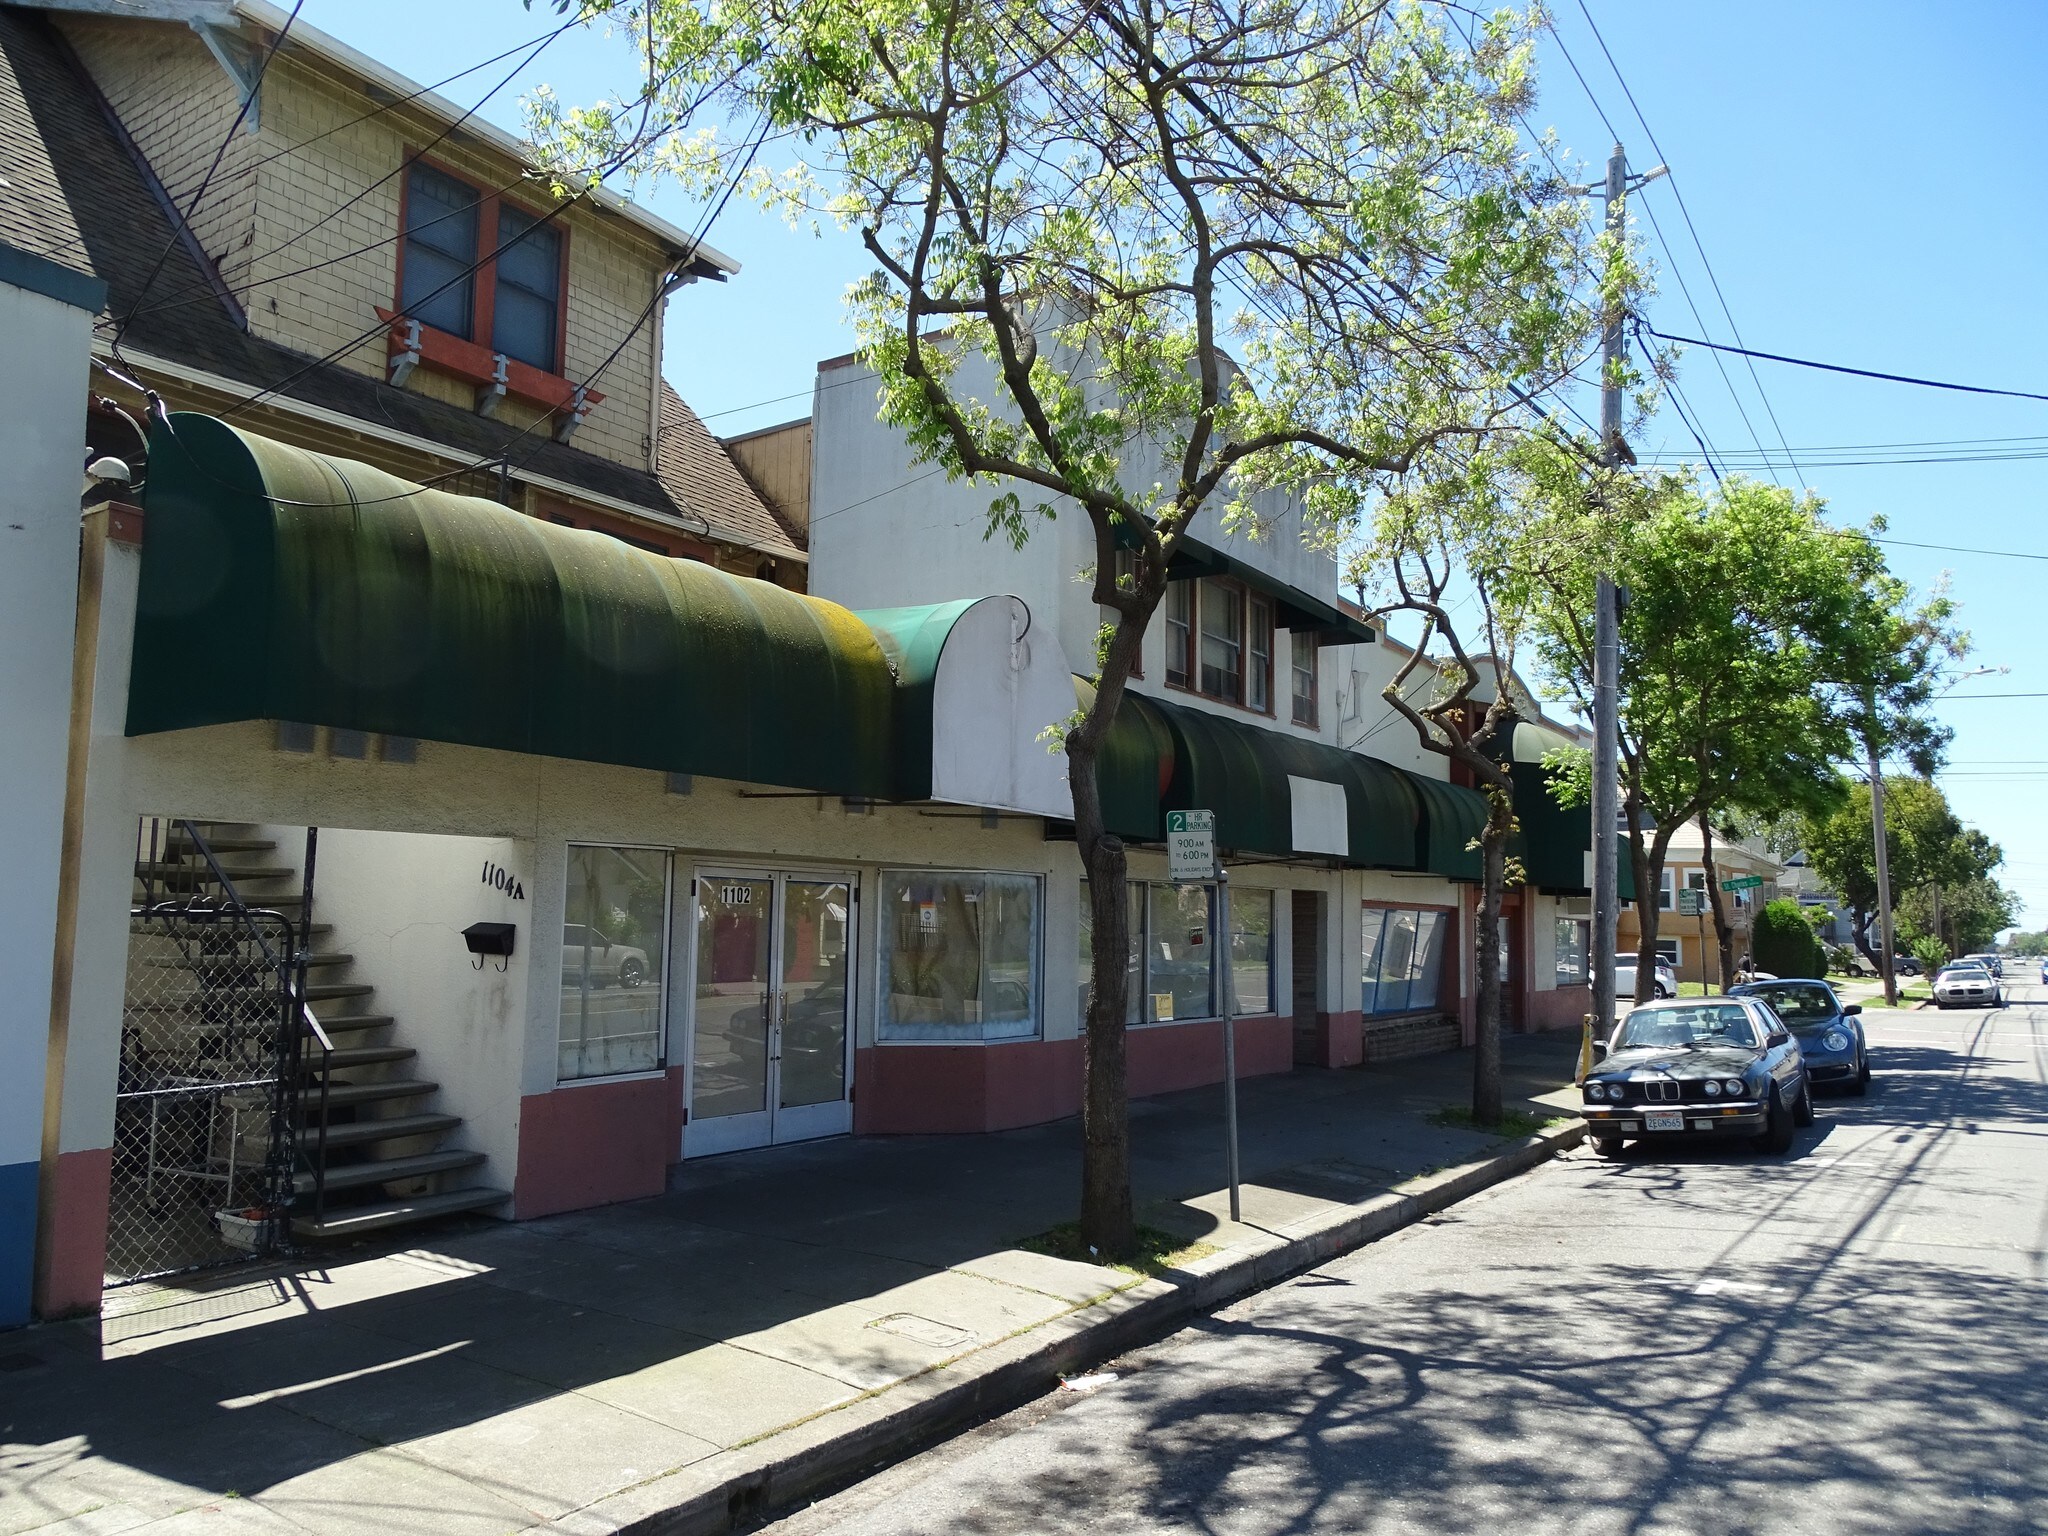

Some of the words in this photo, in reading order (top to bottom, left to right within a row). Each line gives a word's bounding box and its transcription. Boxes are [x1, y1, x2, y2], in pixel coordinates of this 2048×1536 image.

[1173, 814, 1183, 831] 2
[1194, 812, 1203, 821] HR
[1186, 821, 1212, 830] PARKING
[1200, 851, 1209, 859] PM
[481, 860, 525, 900] 1104A
[723, 887, 750, 904] 1102
[1648, 1118, 1681, 1128] 2EGN565
